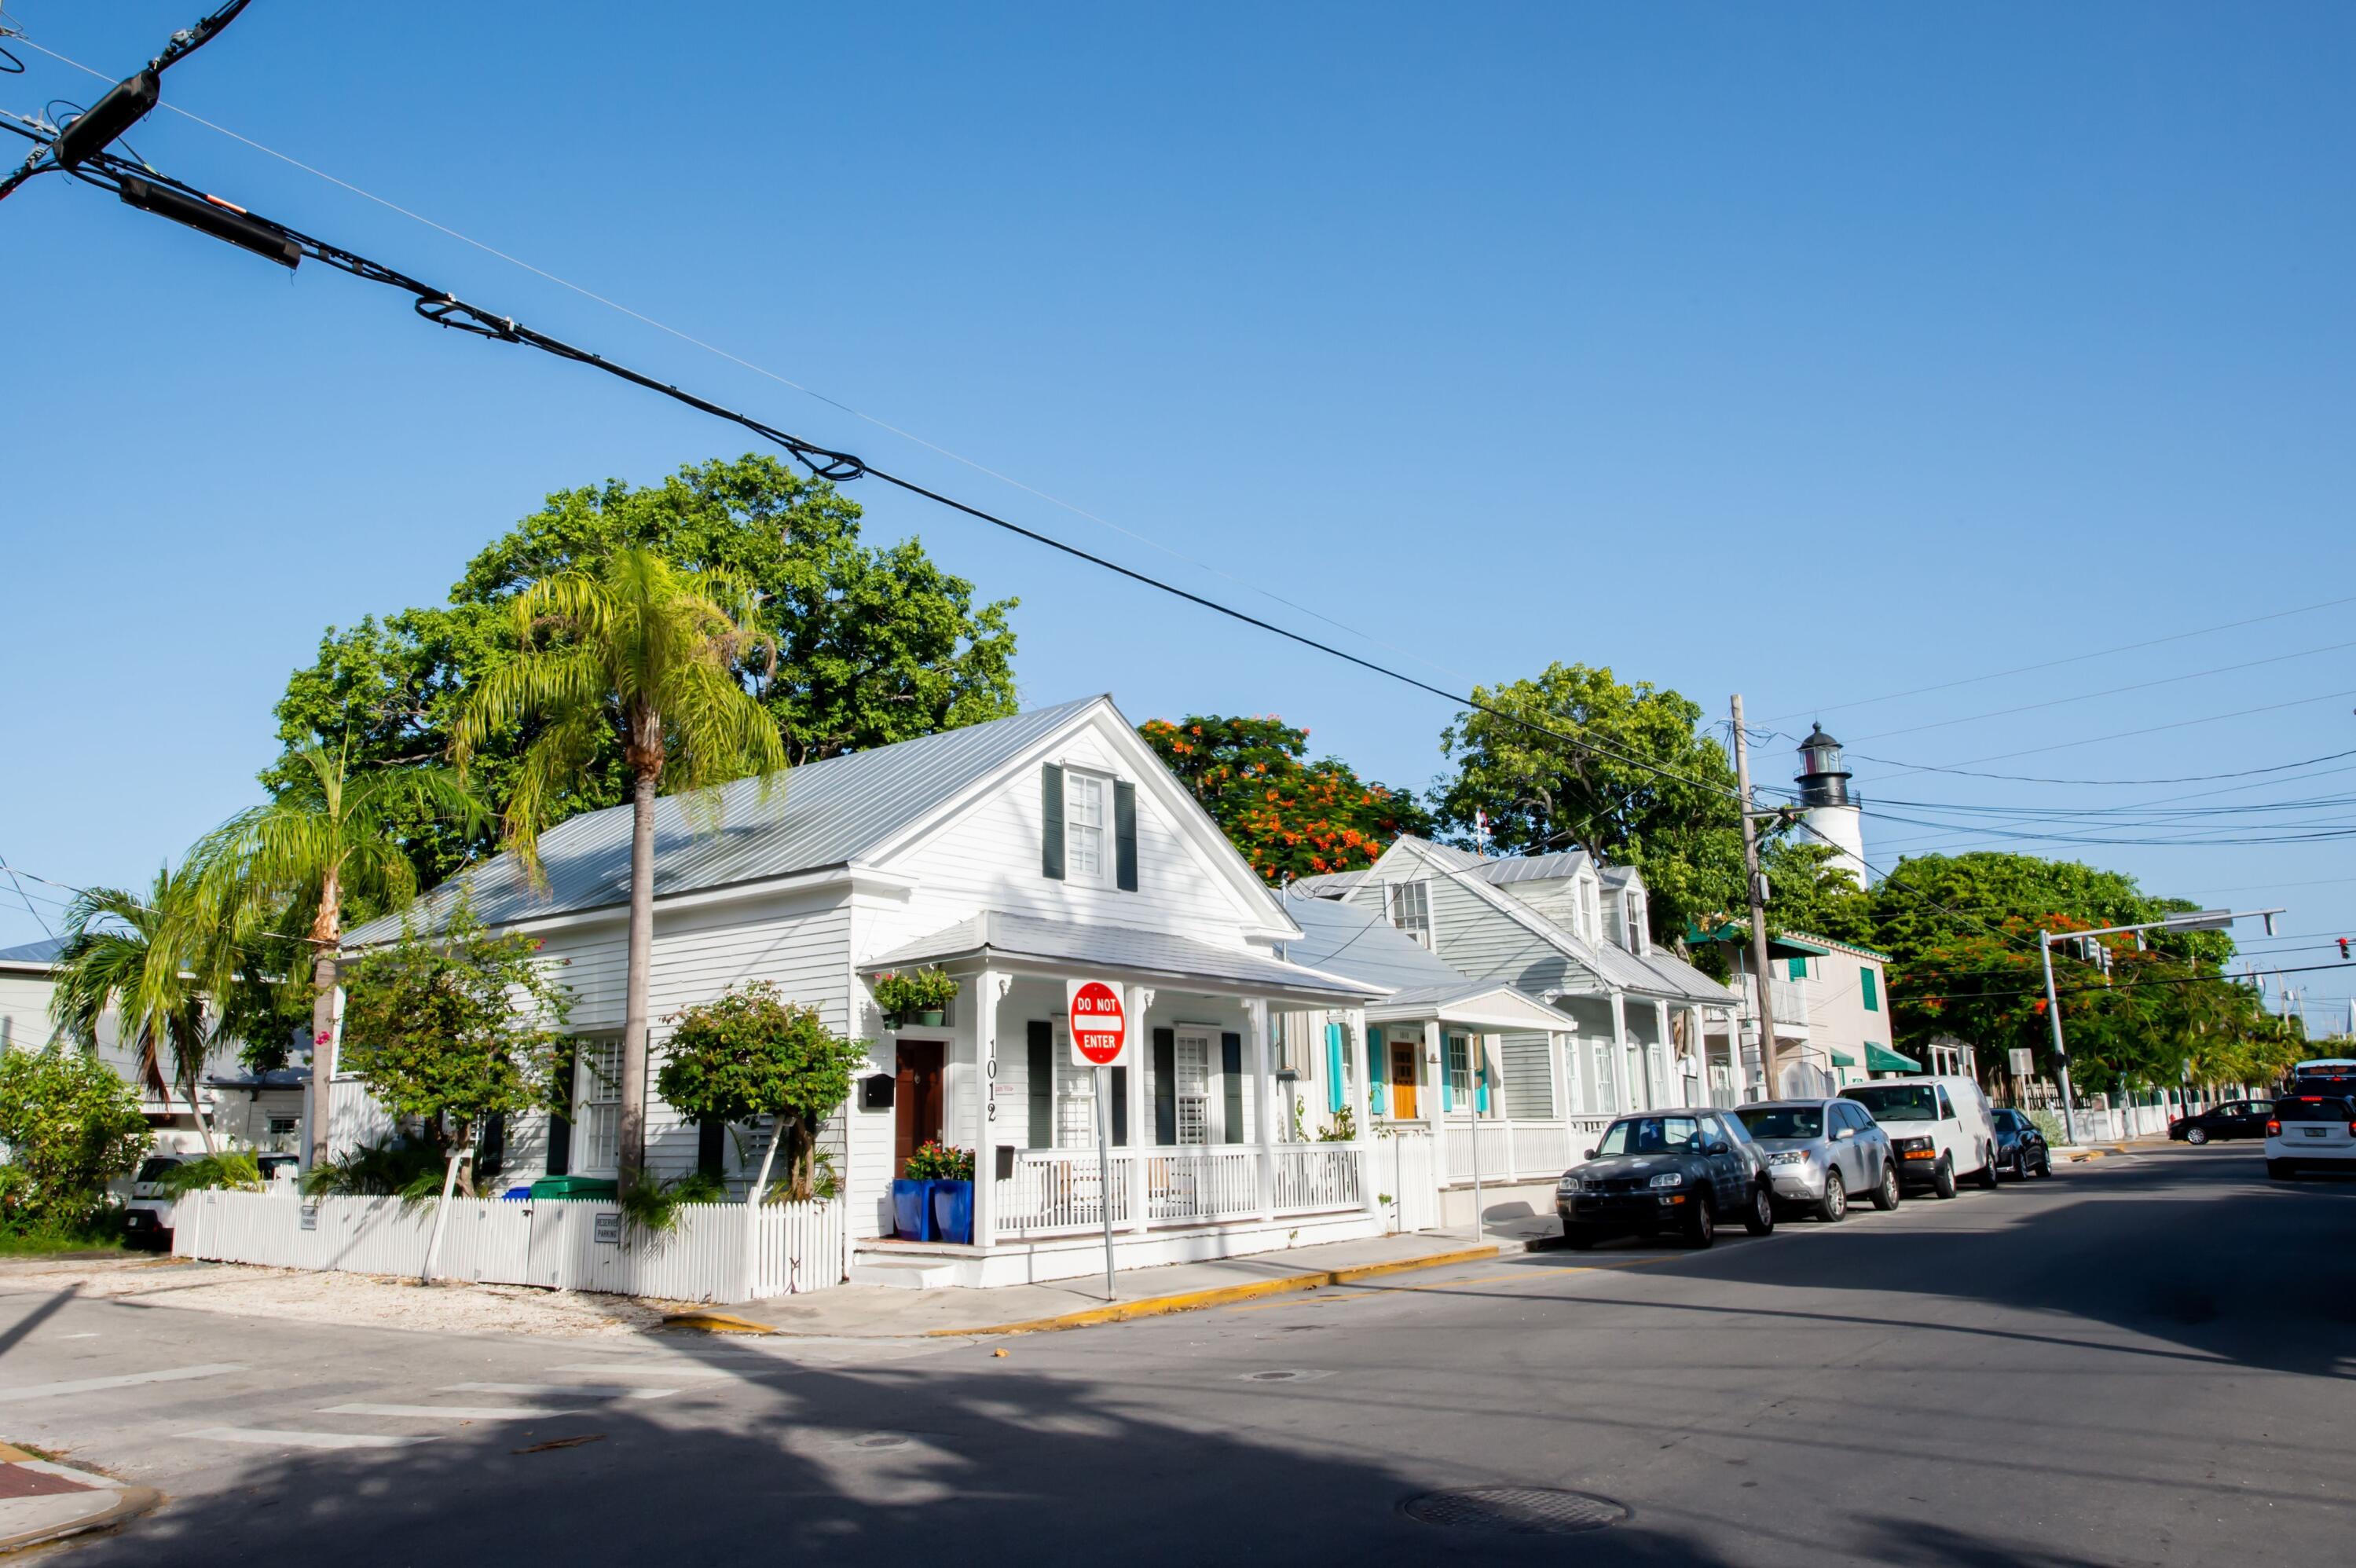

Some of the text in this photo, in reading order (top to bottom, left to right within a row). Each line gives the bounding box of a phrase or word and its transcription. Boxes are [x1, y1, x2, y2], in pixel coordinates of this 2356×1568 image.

[1078, 997, 1116, 1012] DO NOT
[1083, 1035, 1116, 1049] ENTER
[987, 1039, 997, 1123] 1012
[597, 1229, 617, 1238] PARKING
